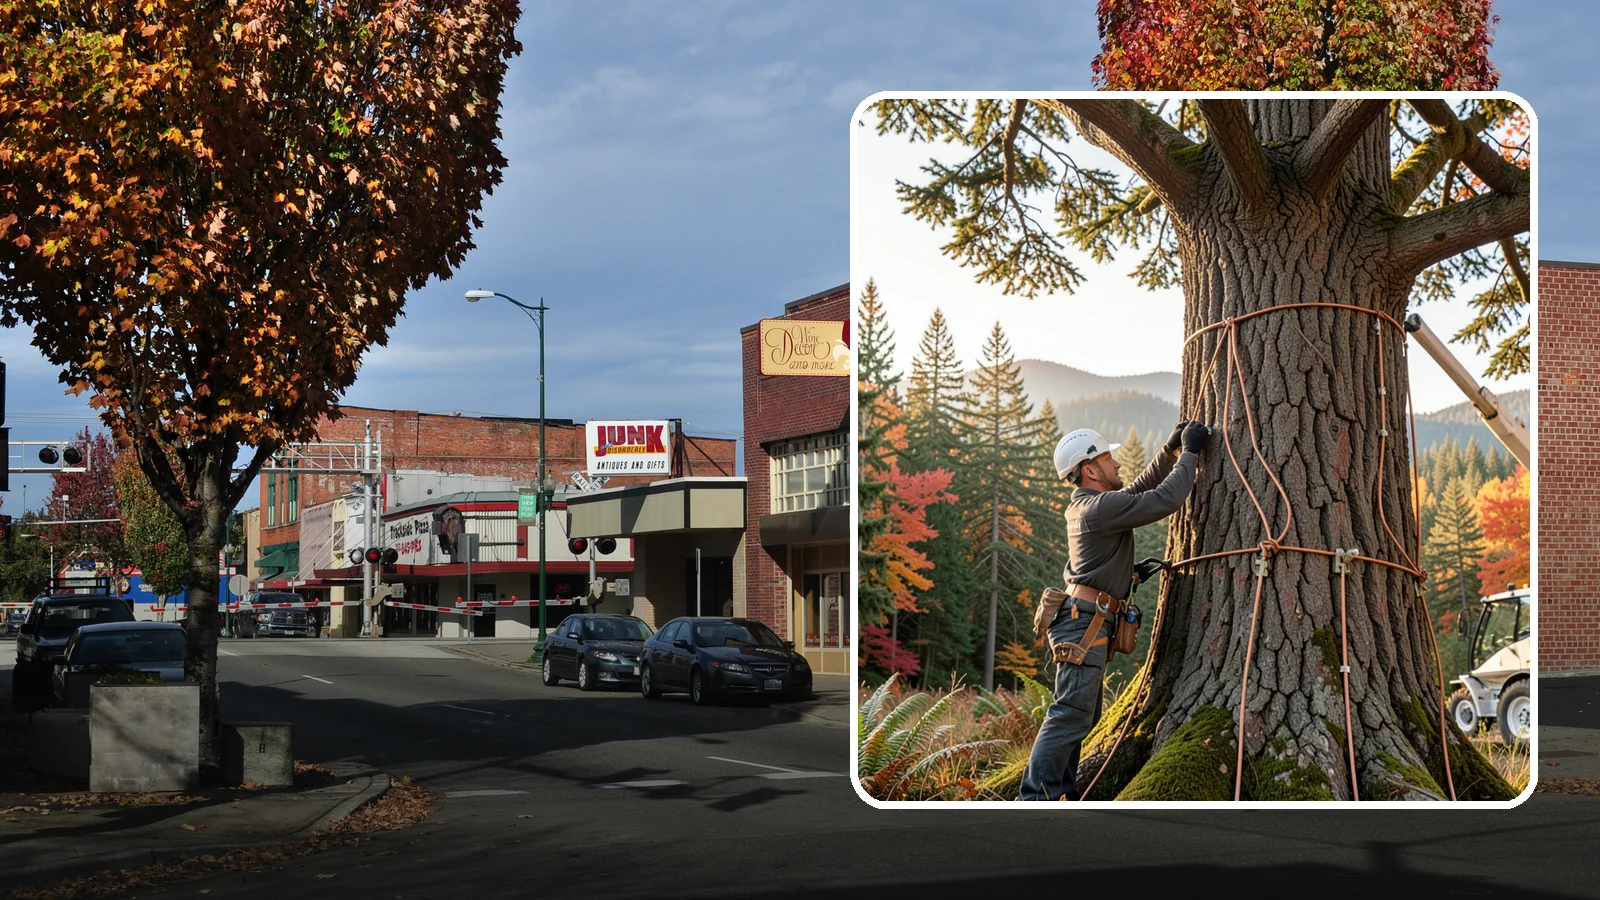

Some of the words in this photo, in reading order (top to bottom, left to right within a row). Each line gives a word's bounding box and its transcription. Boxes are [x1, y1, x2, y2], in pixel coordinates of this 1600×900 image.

[765, 327, 831, 365] Decor
[596, 425, 665, 457] JUNK
[607, 446, 645, 454] DISORDERLY
[597, 461, 628, 470] ANTIQUES
[631, 461, 644, 469] AND
[647, 460, 665, 469] GIFTS
[590, 476, 608, 492] SING
[352, 498, 364, 510] CRO
[414, 519, 429, 535] Pizza
